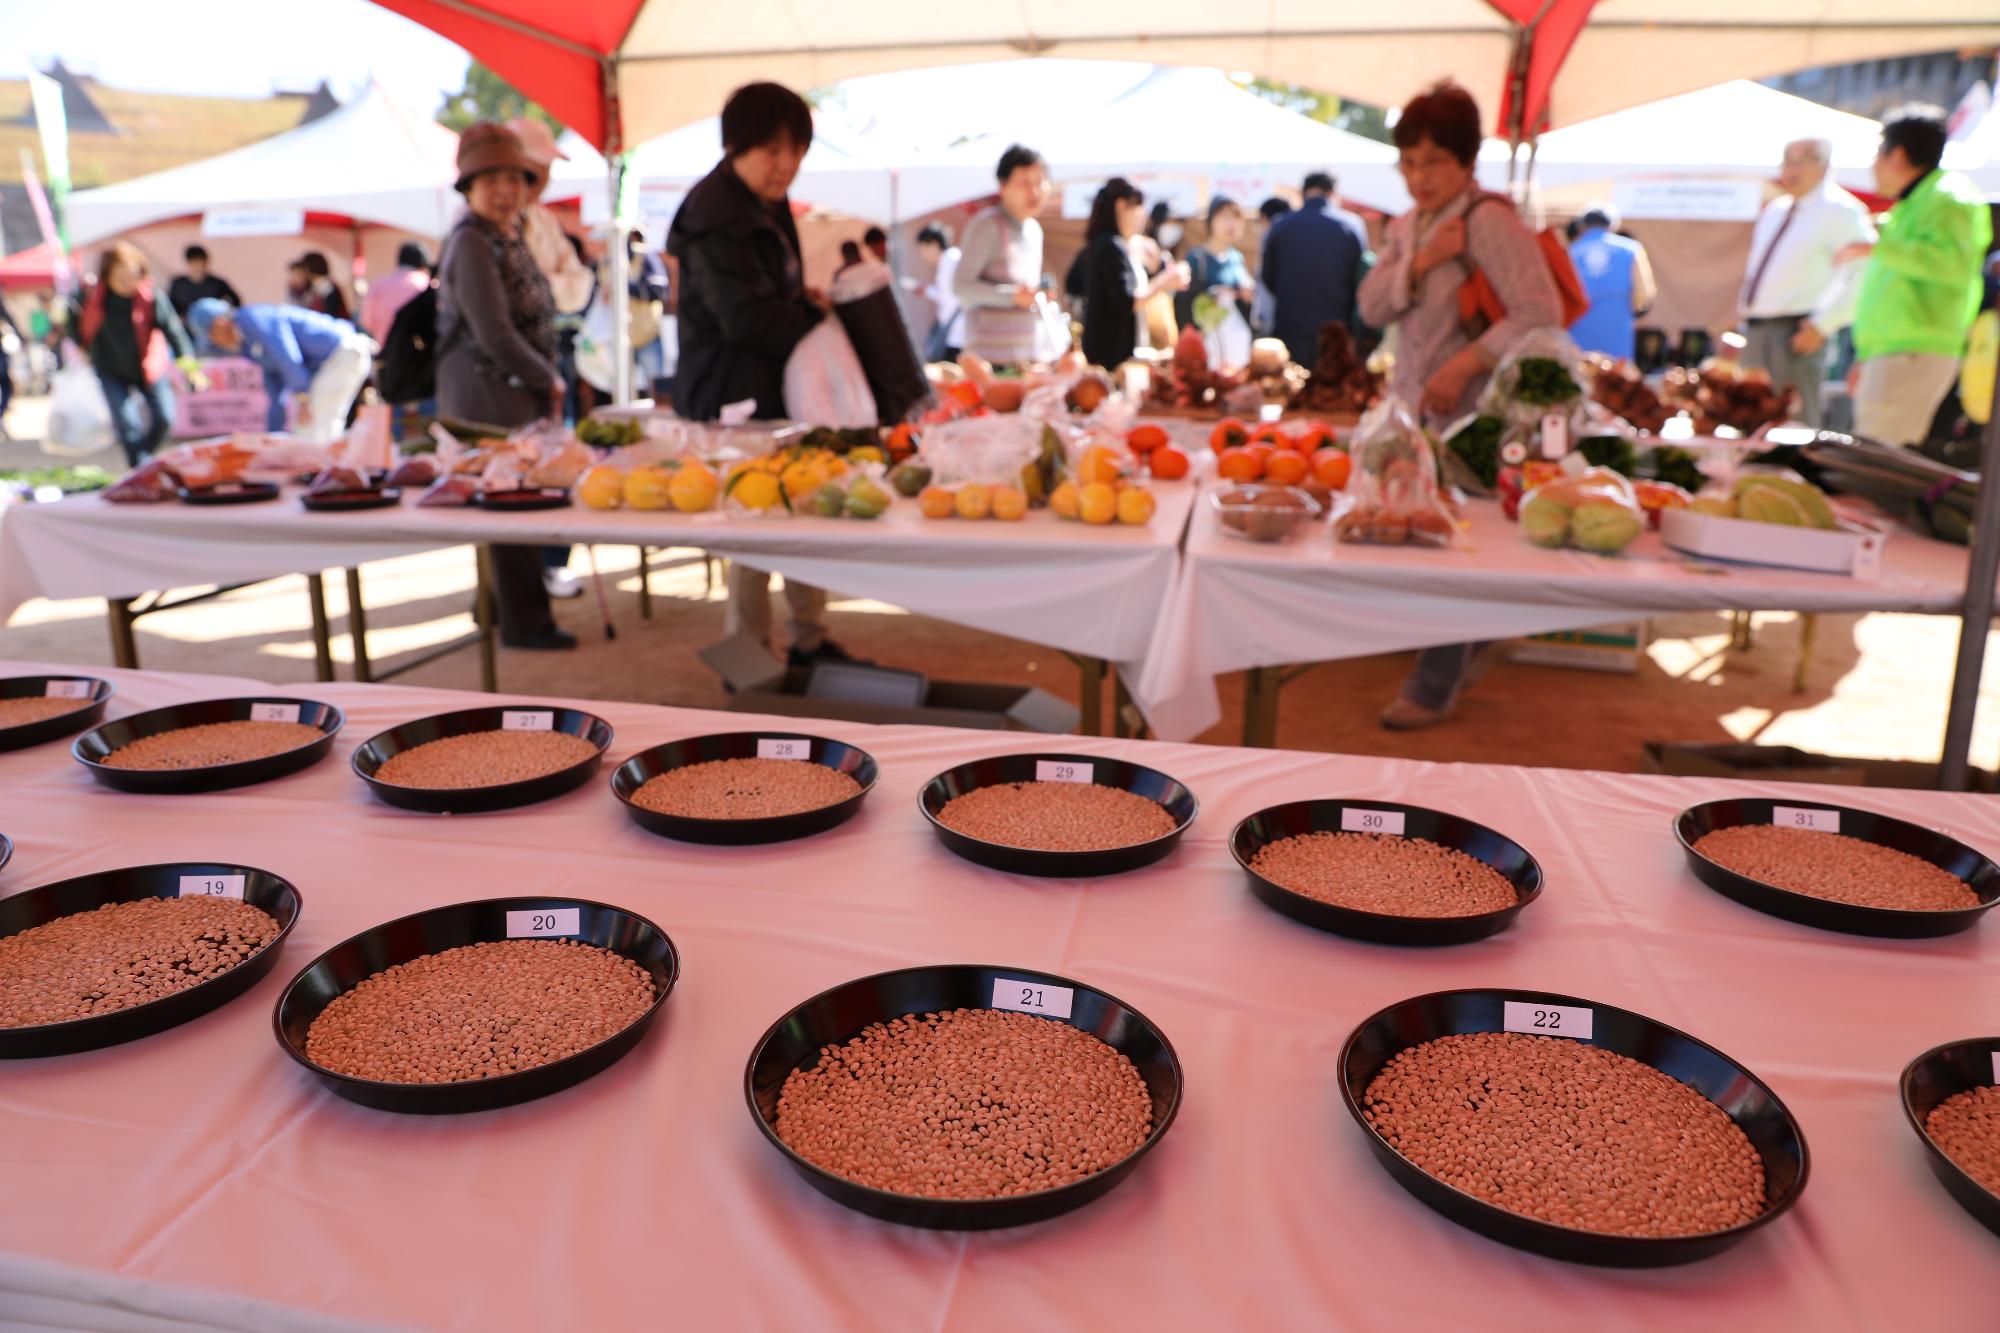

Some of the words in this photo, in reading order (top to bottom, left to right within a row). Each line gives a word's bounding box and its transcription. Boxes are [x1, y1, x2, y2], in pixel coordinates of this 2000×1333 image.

[269, 708, 283, 718] 26
[521, 716, 536, 726] 27
[776, 744, 792, 755] 28
[1056, 767, 1073, 778] 29
[1363, 815, 1382, 828] 30
[1796, 812, 1813, 826] 31
[205, 881, 224, 895] 19
[533, 915, 555, 930] 20
[1021, 989, 1043, 1007] 21
[1534, 1010, 1560, 1029] 22
